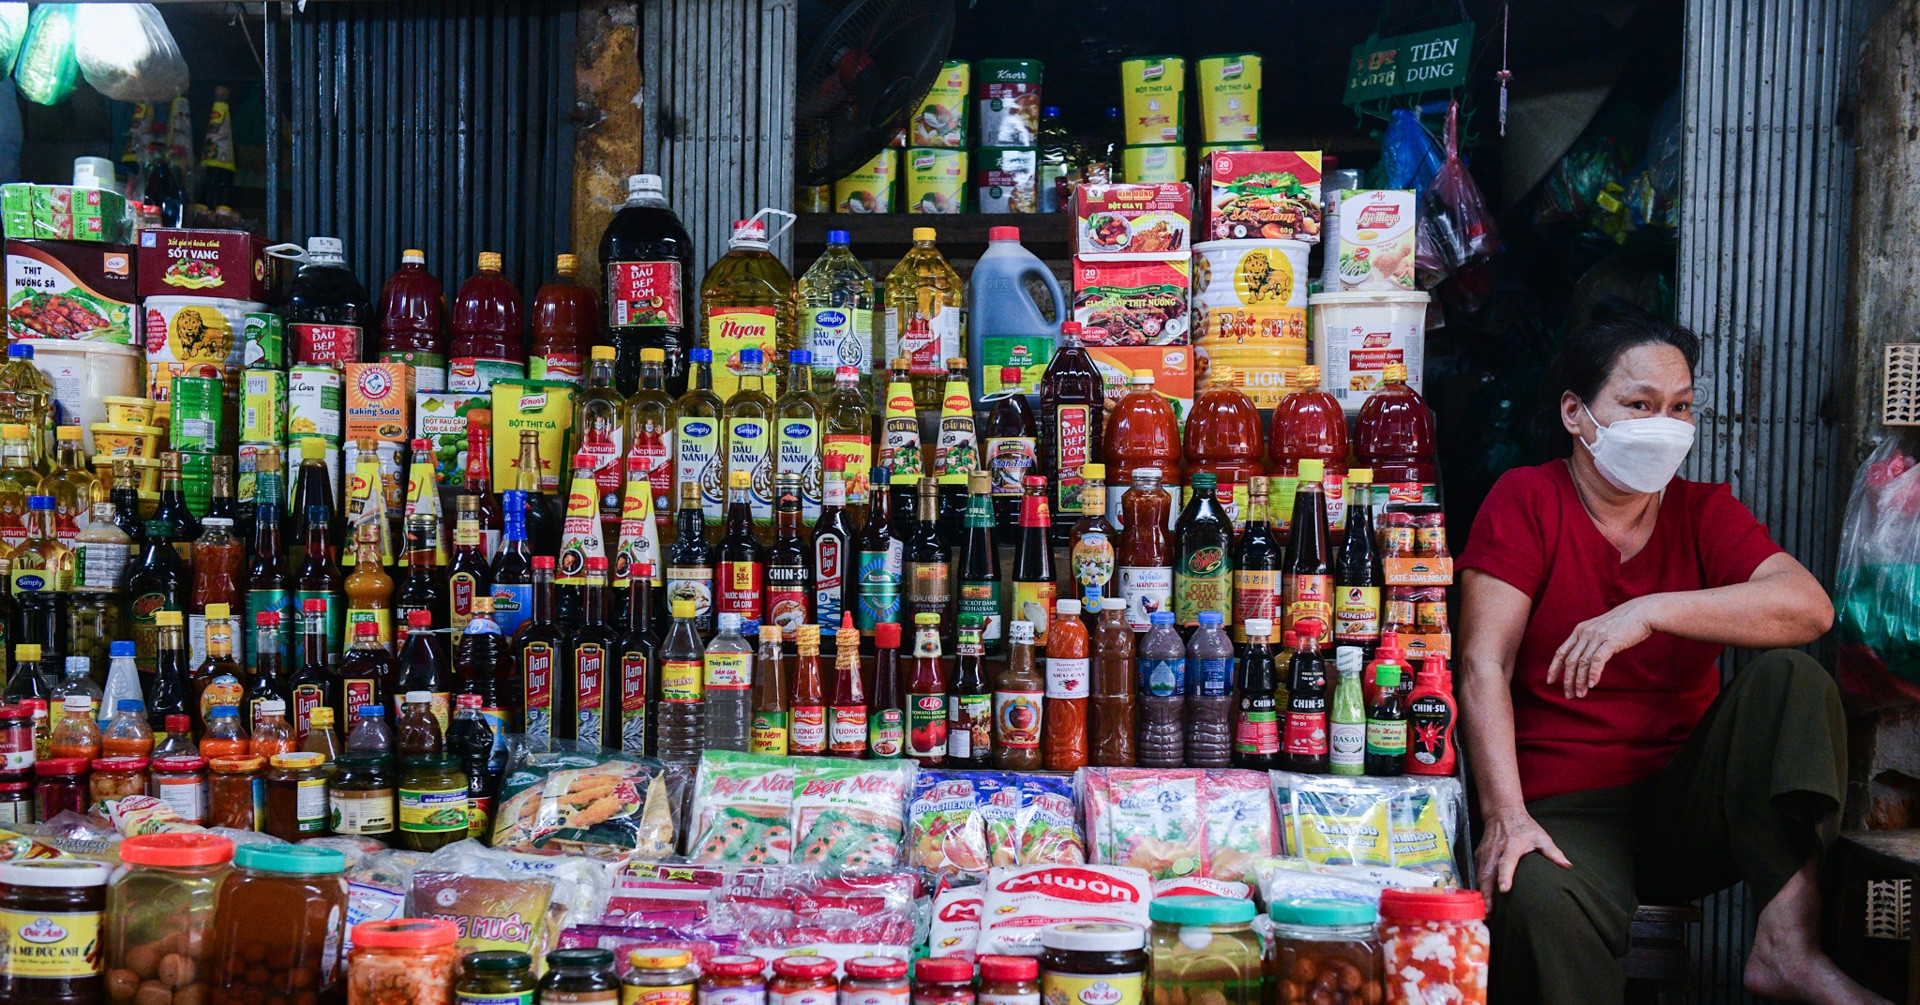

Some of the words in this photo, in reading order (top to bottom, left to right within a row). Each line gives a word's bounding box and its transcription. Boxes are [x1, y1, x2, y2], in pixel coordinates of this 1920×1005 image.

[1411, 38, 1459, 63] TIỆN
[997, 69, 1027, 80] Knorr
[1406, 63, 1454, 82] DỤNG
[1135, 202, 1143, 210] VỊ
[190, 250, 219, 260] VANG
[24, 266, 42, 277] THỊT
[1085, 299, 1100, 307] GIA
[1128, 299, 1146, 308] THỊT
[817, 313, 845, 325] Simply
[720, 320, 765, 339] Ngon
[1218, 311, 1257, 344] Bột
[1351, 353, 1386, 361] Professional
[1244, 372, 1285, 387] LION
[298, 382, 315, 391] Corn
[520, 397, 545, 408] Knorr
[349, 408, 377, 417] Baking
[509, 419, 524, 429] BỘT
[525, 420, 543, 429] THỊT
[544, 420, 556, 429] GÀ
[685, 425, 710, 435] Simply
[736, 426, 760, 436] Simply
[786, 426, 810, 435] Simply
[583, 444, 615, 454] Neptune
[633, 447, 666, 456] Neptune
[0, 529, 26, 538] eptune
[736, 573, 749, 582] 584
[768, 568, 809, 580] CHIN-SU
[18, 578, 43, 588] Simply
[1190, 584, 1218, 593] OLIVE
[1185, 592, 1225, 601] POMACE
[1196, 601, 1213, 609] OIL
[529, 655, 549, 672] Nam
[580, 656, 600, 673] Nam
[625, 665, 642, 679] Nam
[923, 697, 939, 709] Life
[1412, 703, 1446, 713] CHIN-SU
[794, 710, 822, 718] Cholimex
[837, 710, 866, 718] Cholimex
[710, 776, 751, 797] Bột
[802, 778, 846, 798] Bột
[1004, 873, 1132, 900] Miwon
[471, 913, 532, 943] MUỐI
[60, 947, 79, 957] ANH
